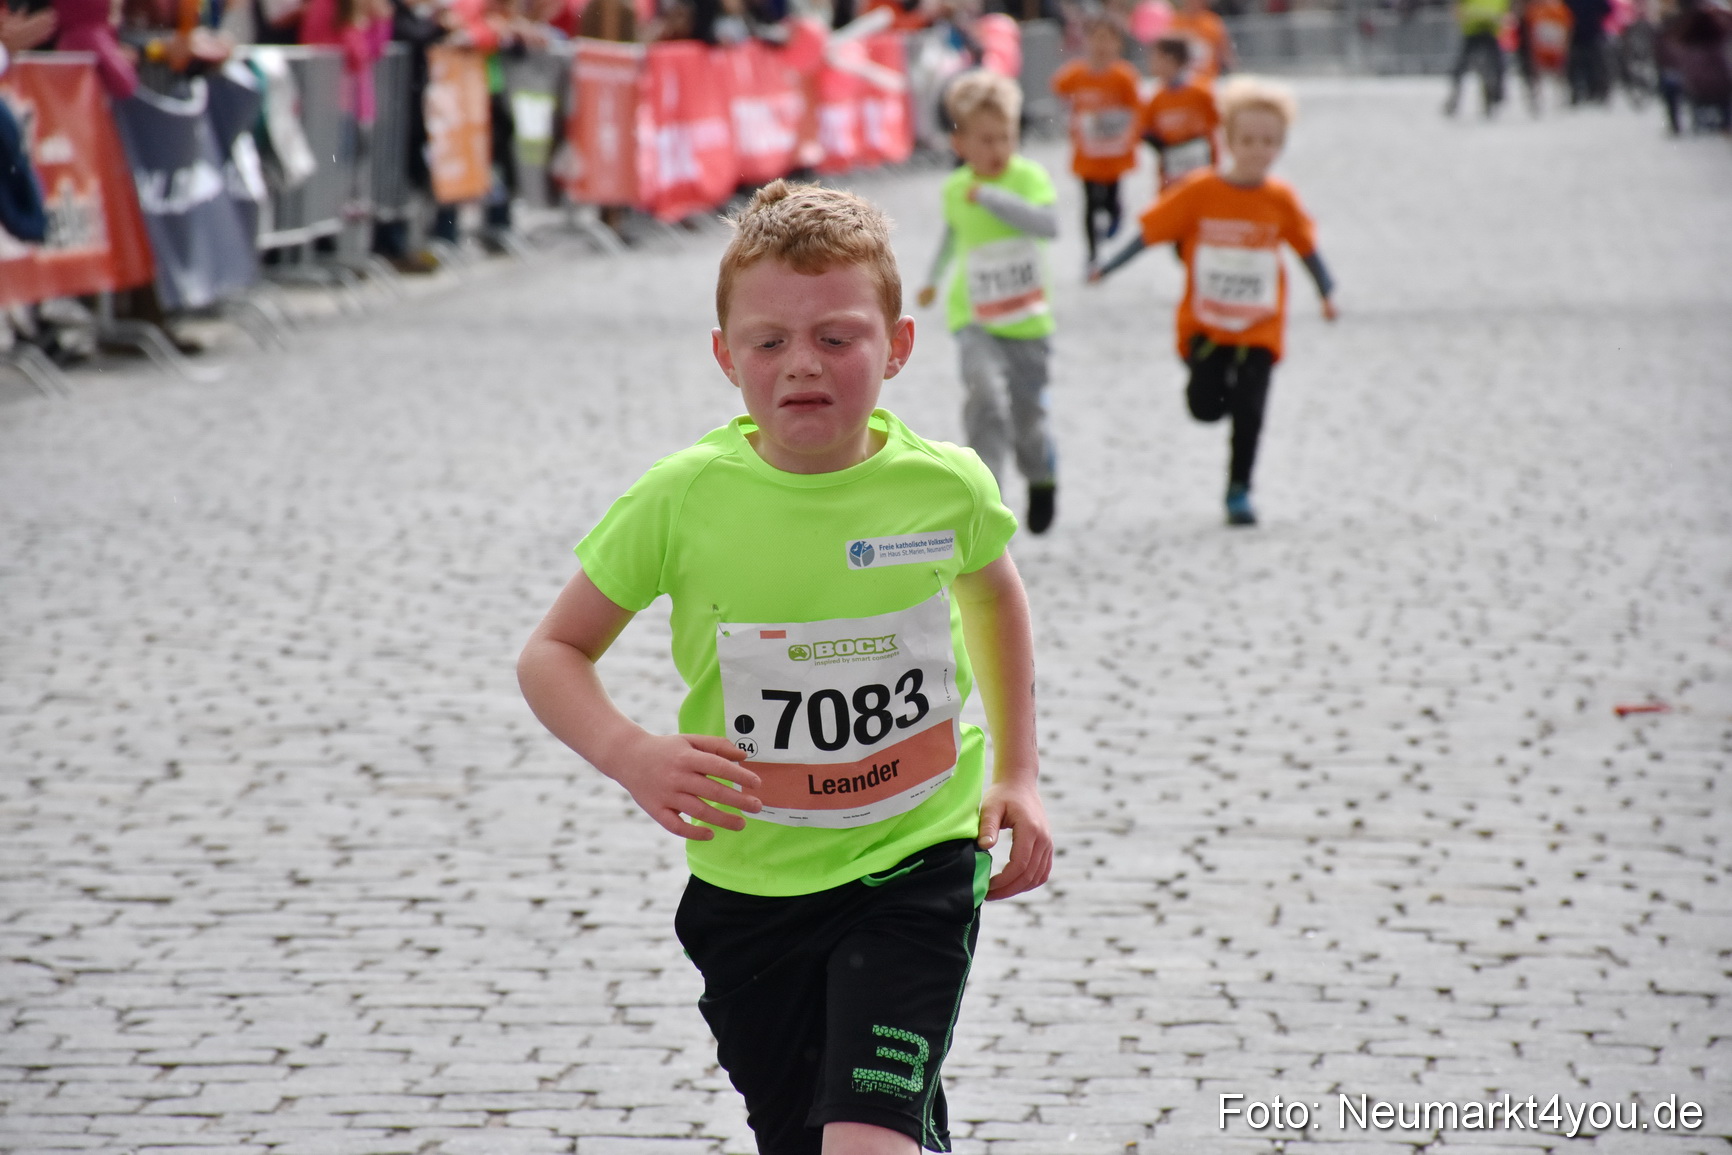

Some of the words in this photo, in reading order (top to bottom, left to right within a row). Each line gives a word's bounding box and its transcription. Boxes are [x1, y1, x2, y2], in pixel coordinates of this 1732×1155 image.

[879, 543, 894, 551] Freie
[896, 540, 927, 549] katholische
[888, 550, 901, 558] Haus
[813, 634, 898, 659] BOCK
[815, 658, 841, 666] inspired
[842, 656, 851, 664] by
[872, 651, 900, 661] concepts
[761, 668, 930, 752] 7083
[808, 758, 900, 795] Leander
